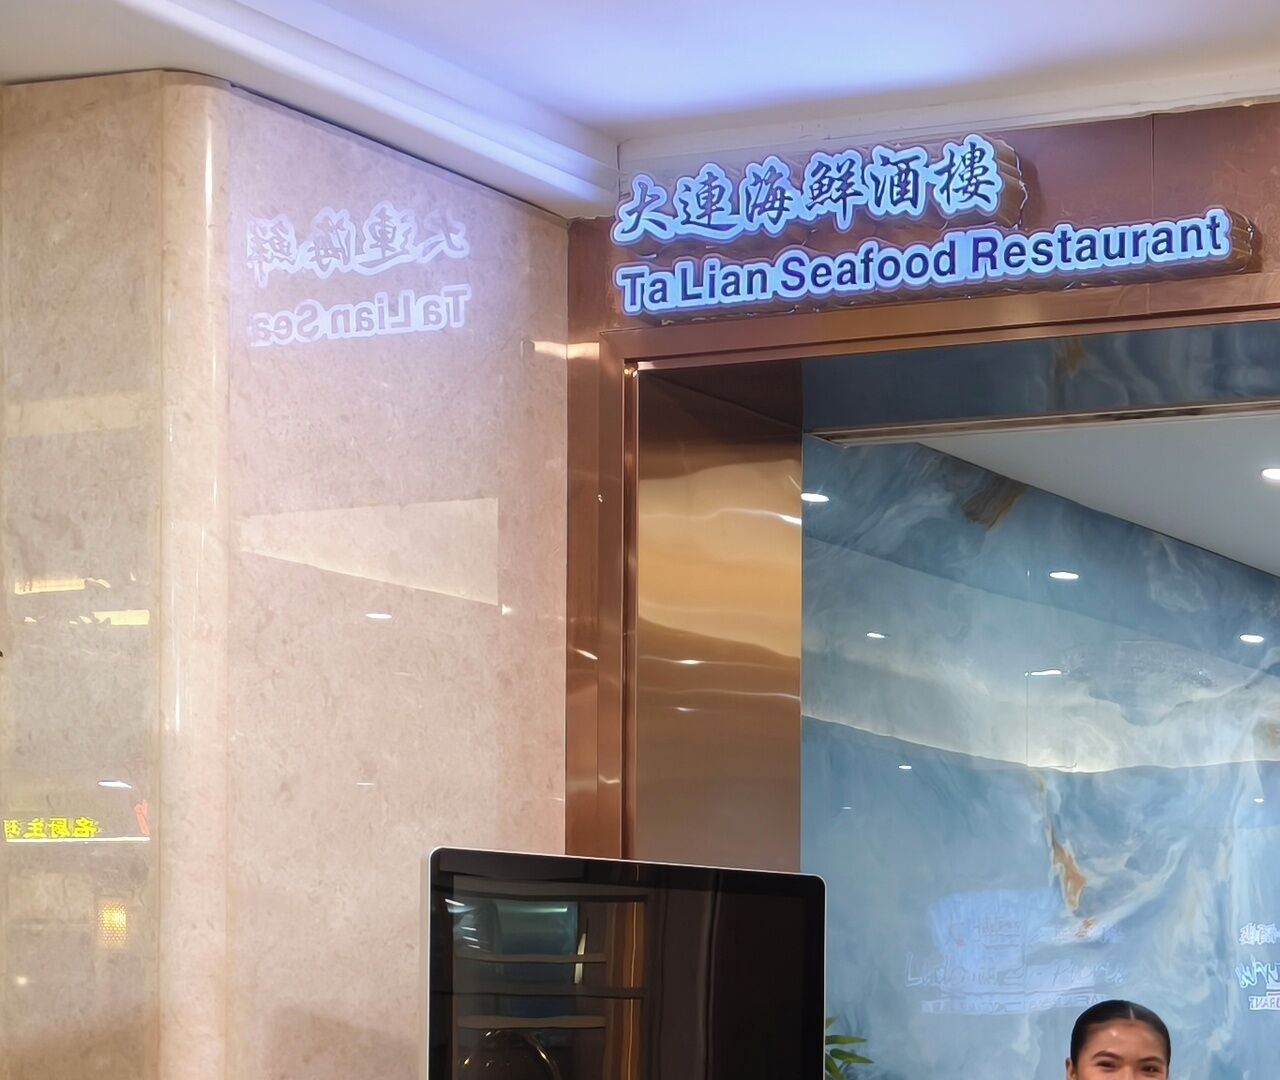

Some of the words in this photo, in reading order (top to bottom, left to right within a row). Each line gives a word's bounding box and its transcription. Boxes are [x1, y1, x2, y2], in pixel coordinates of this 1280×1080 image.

[617, 138, 999, 238] 大連海鮮酒樓
[780, 238, 957, 293] Seafood
[971, 214, 1223, 274] Restaurant
